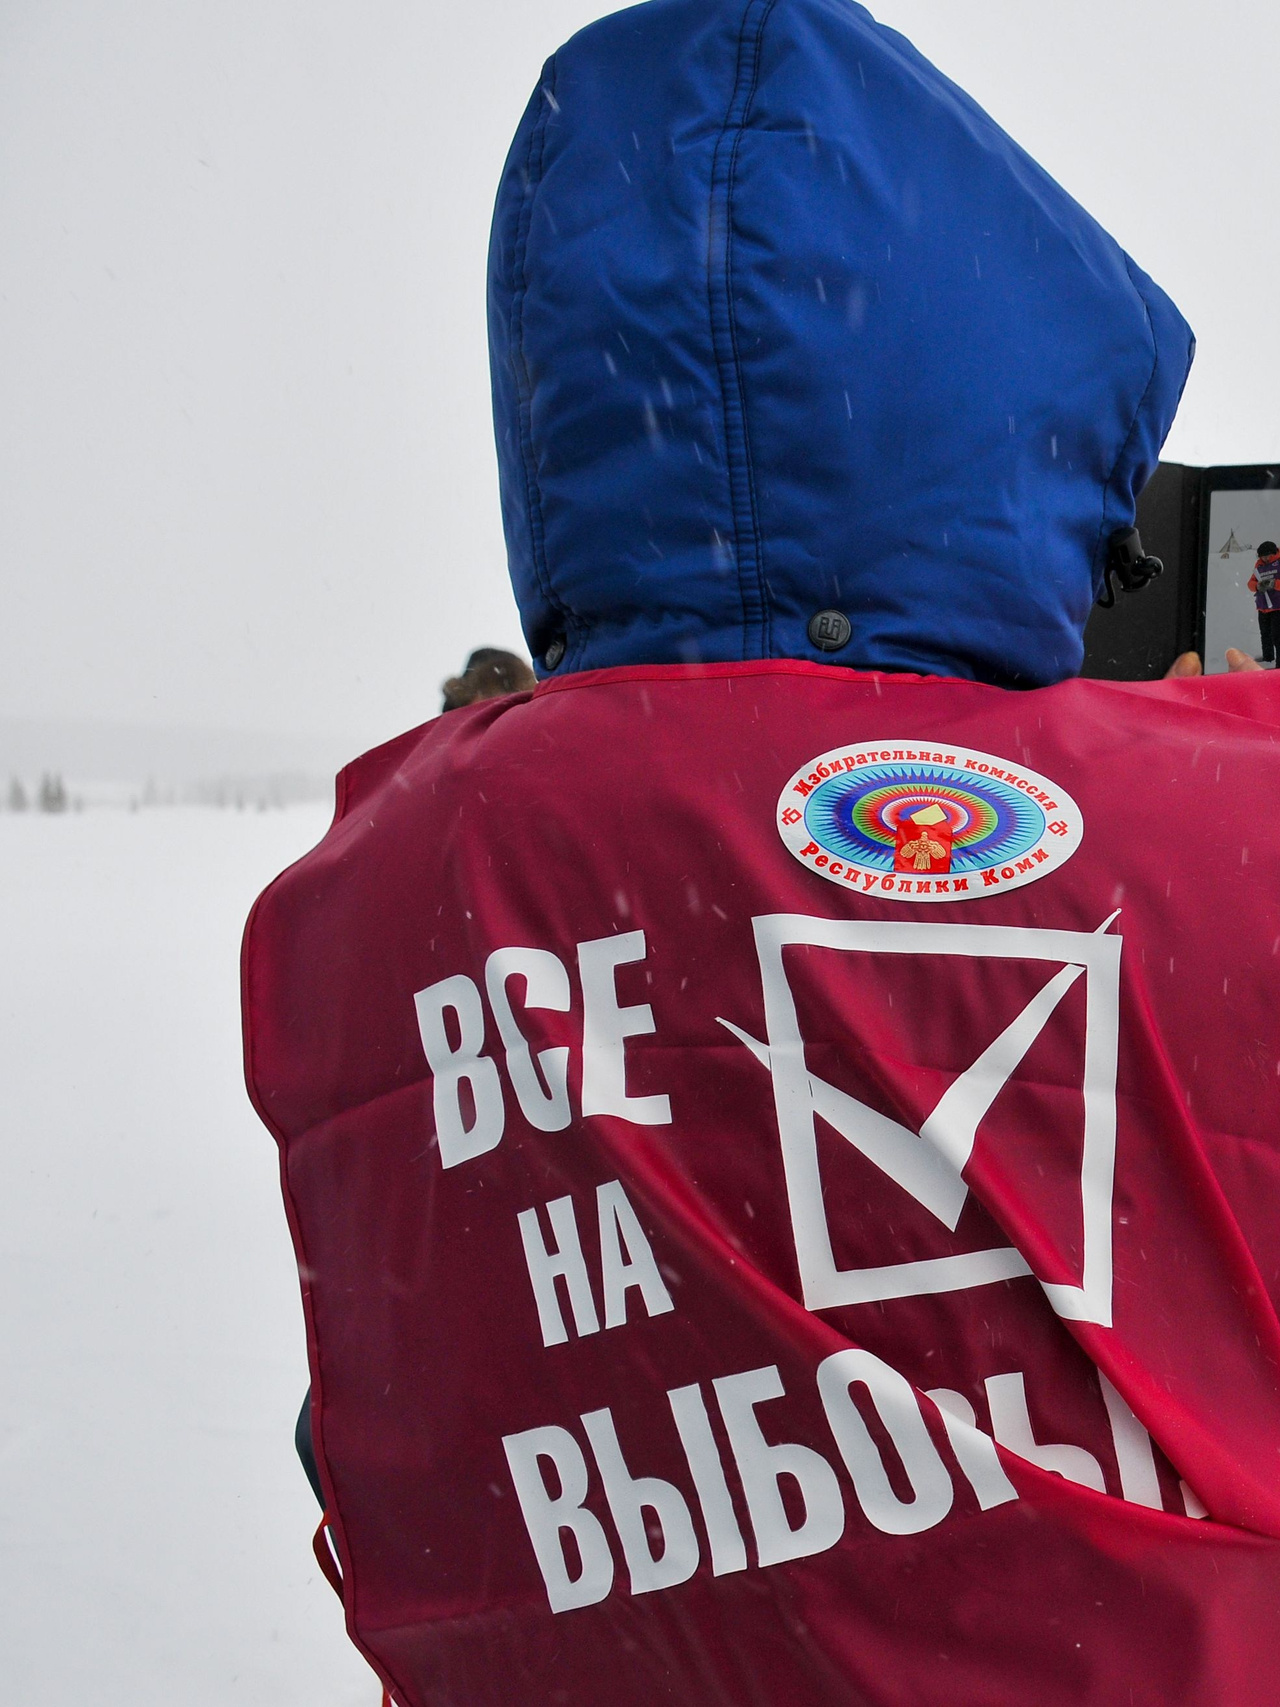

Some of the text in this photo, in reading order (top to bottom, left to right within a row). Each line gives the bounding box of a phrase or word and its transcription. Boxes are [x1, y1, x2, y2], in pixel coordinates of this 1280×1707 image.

[793, 749, 1058, 812] Избирательная комиссия
[799, 841, 1049, 894] Республики Коми
[413, 929, 673, 1170] ВСЕ
[517, 1180, 675, 1348] НА
[501, 1348, 1210, 1614] ВЫБОРЫ
